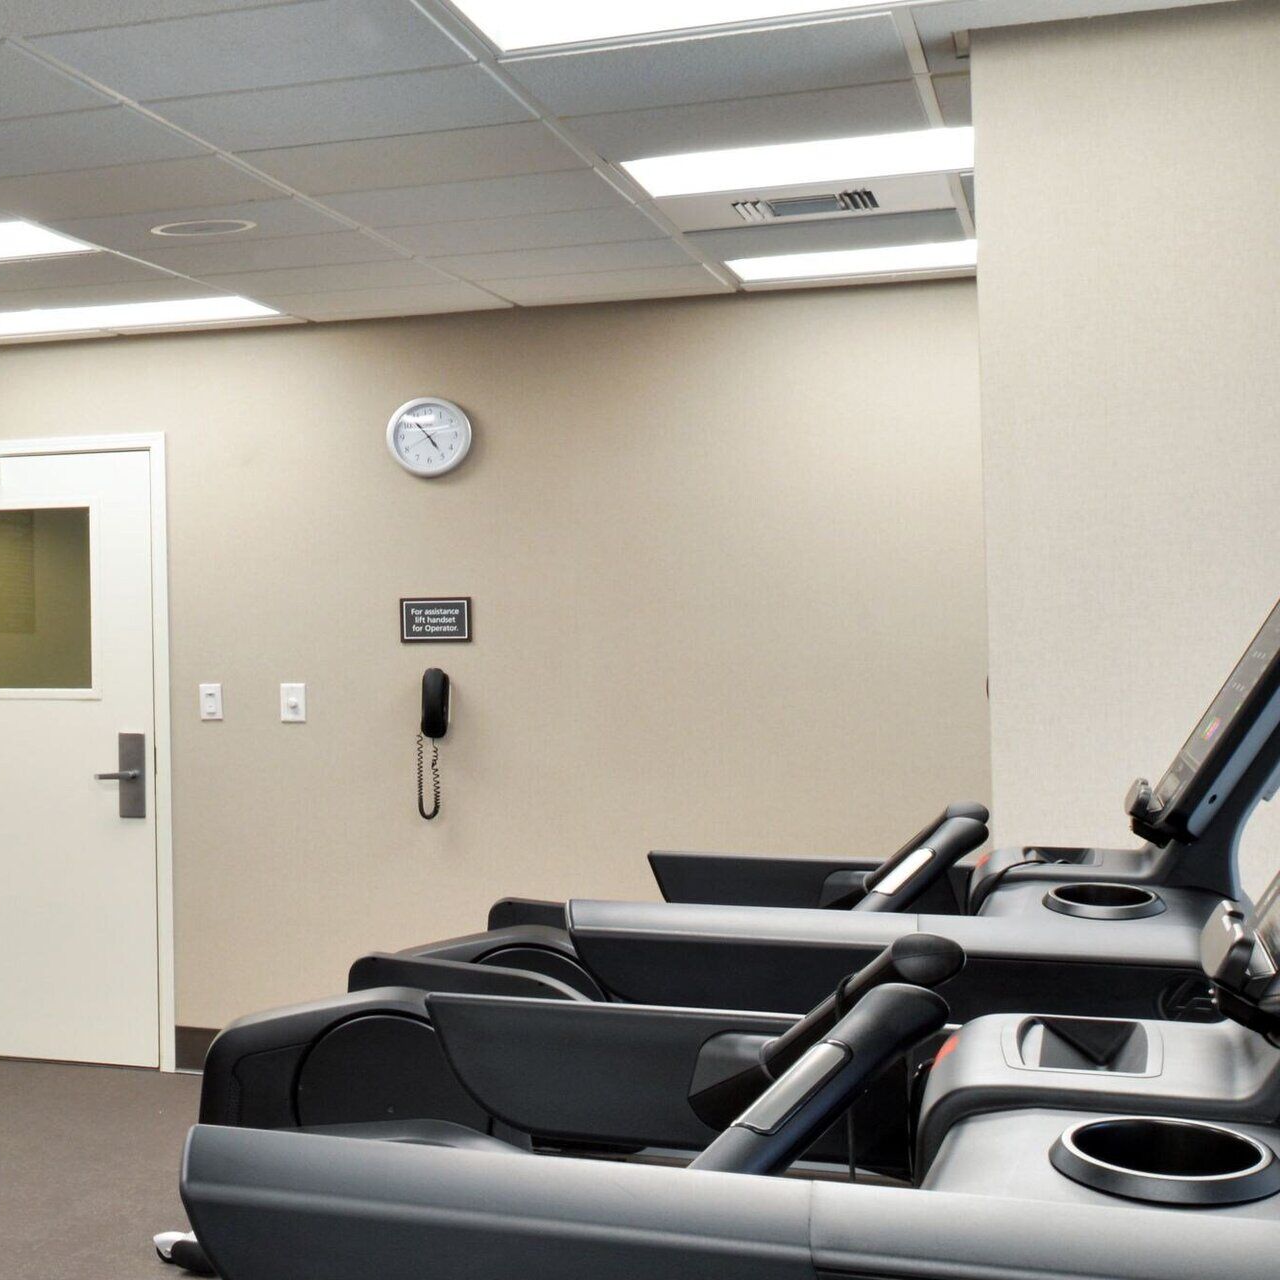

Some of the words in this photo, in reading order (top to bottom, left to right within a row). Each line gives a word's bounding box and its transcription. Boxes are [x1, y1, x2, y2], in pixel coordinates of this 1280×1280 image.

[411, 608, 423, 616] For
[424, 607, 460, 616] assistance
[414, 616, 426, 624] lift
[427, 615, 456, 624] handset
[412, 624, 423, 632] for
[424, 624, 459, 634] Operator.
